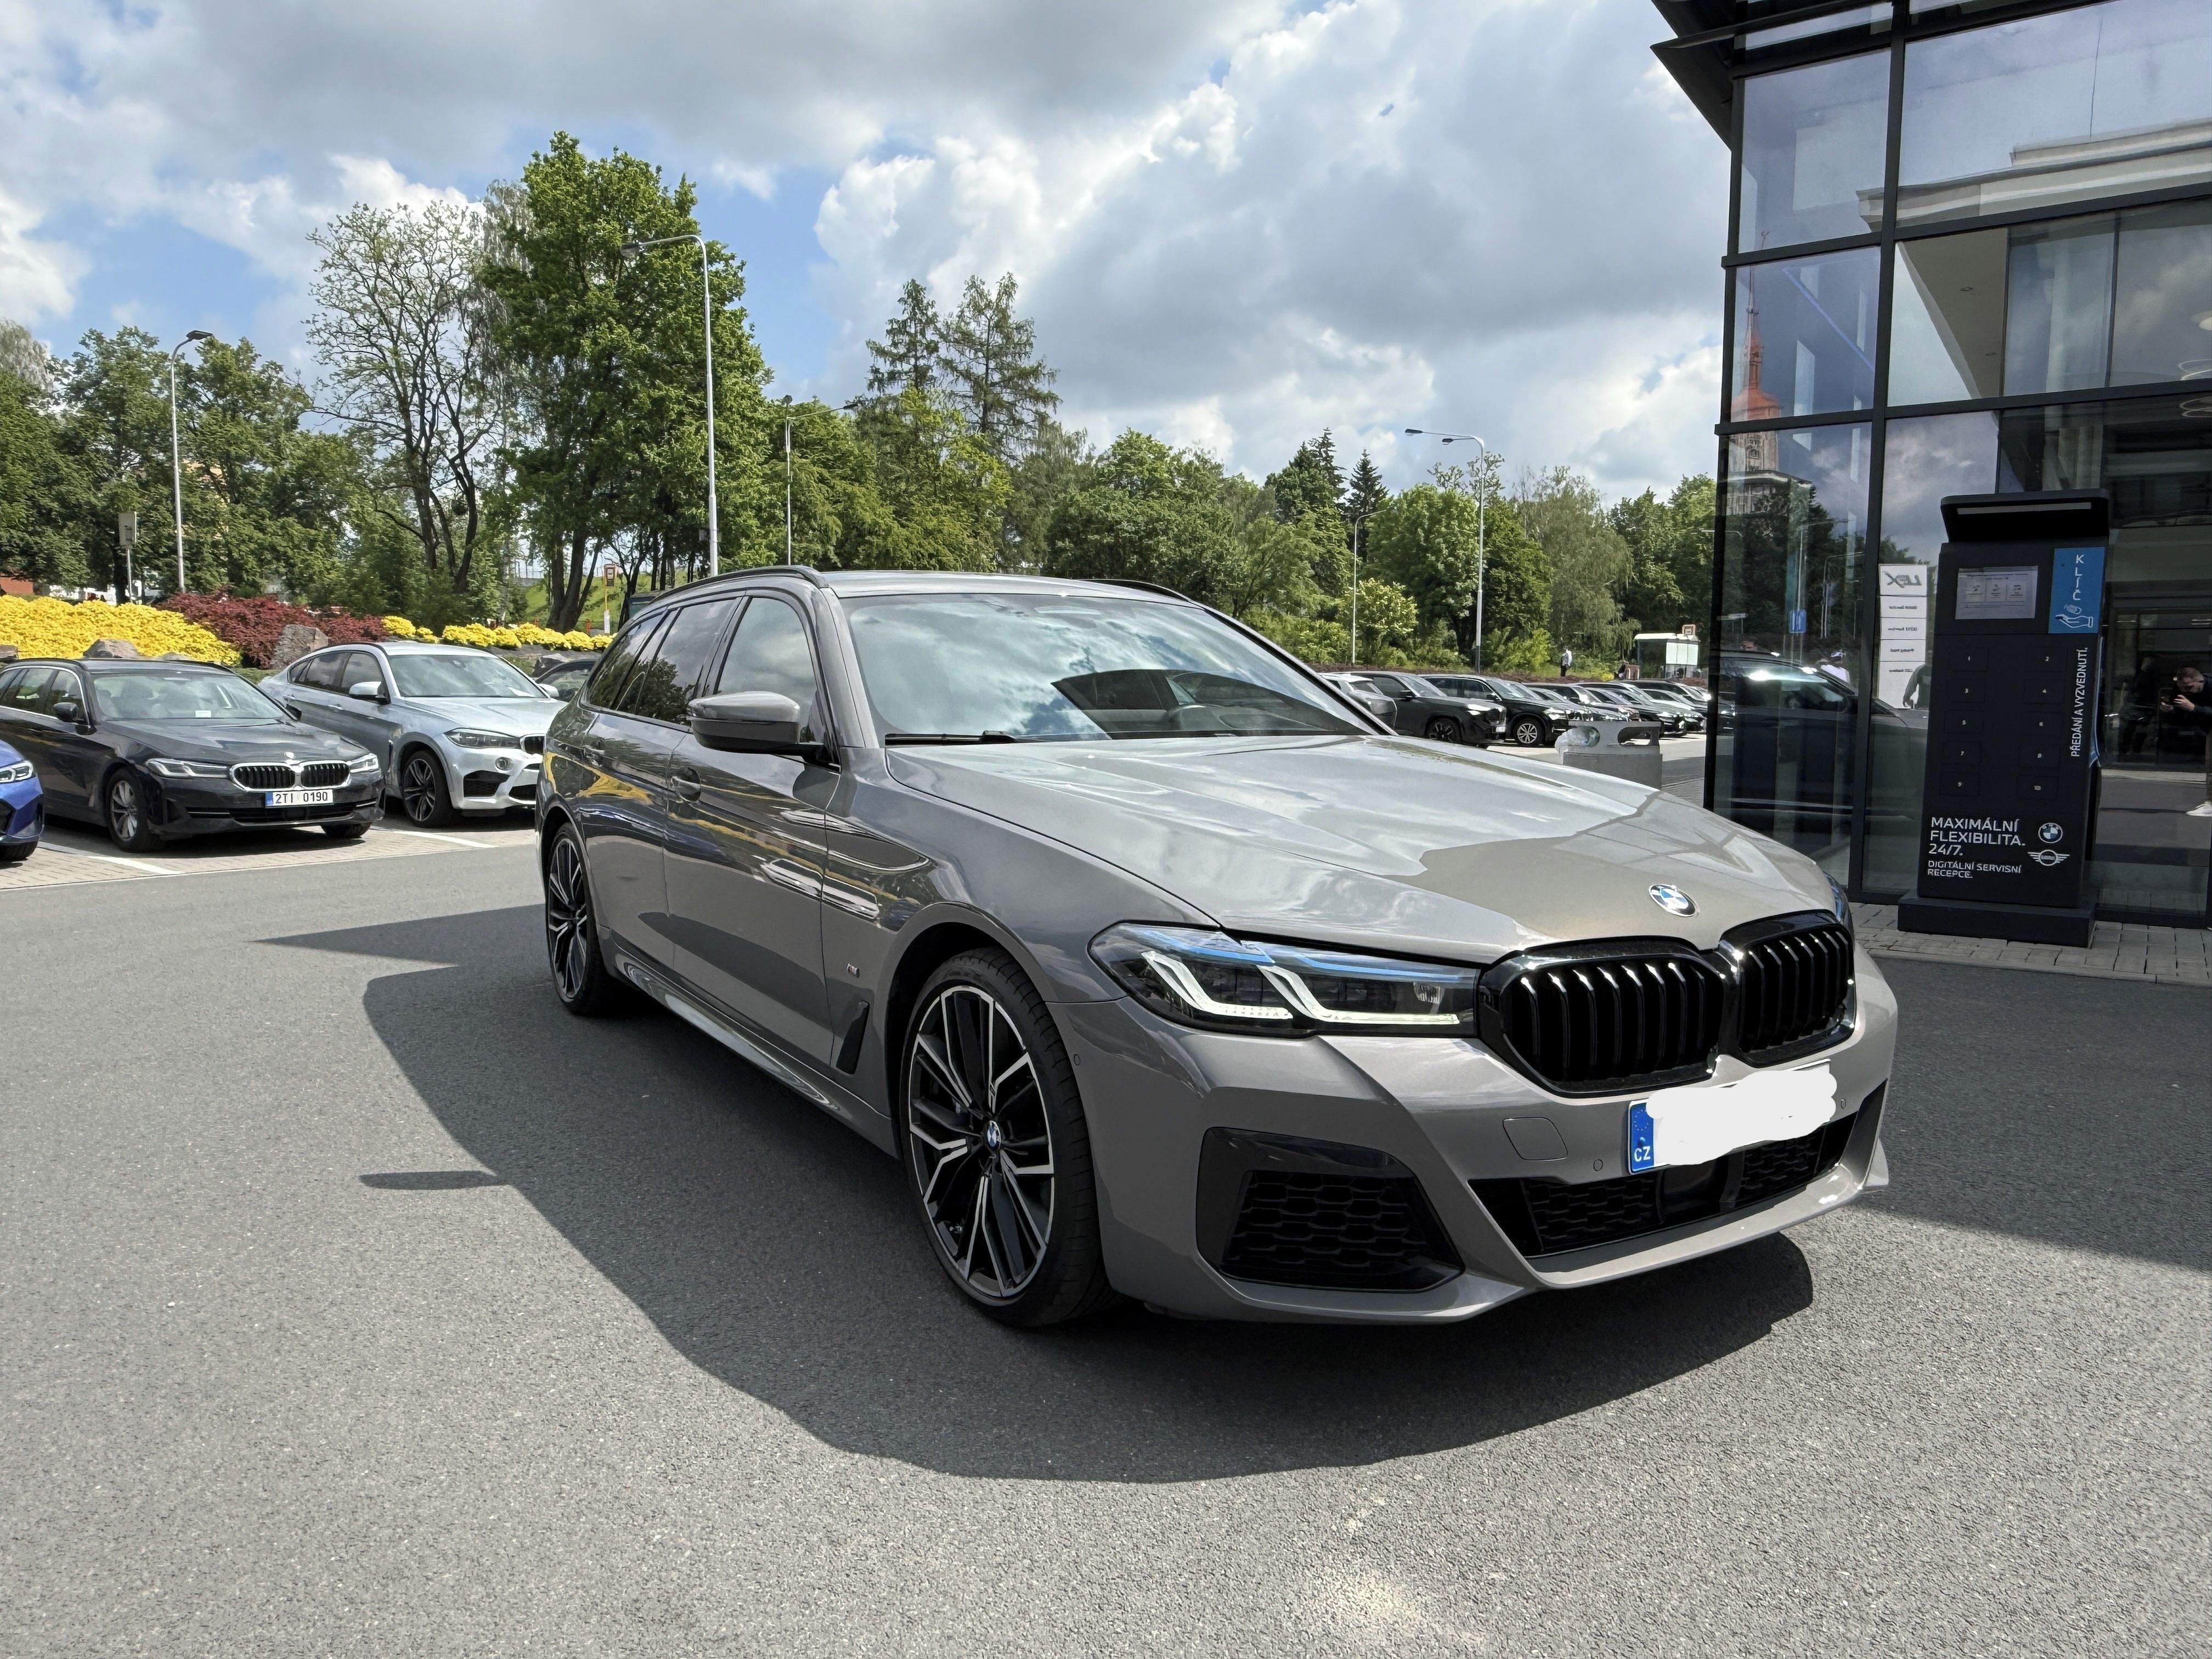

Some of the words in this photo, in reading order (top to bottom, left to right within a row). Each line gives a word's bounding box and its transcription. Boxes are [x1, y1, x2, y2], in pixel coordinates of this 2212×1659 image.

[2072, 554, 2085, 601] KLÍČ
[2069, 717, 2084, 757] PŘEDÁNÍ
[303, 791, 329, 802] 0190
[1931, 816, 2020, 833] MAXIMÁLNÍ
[1930, 830, 2025, 846] FLEXIBILITA.
[1928, 843, 1963, 856] 24/7.
[1928, 860, 1975, 870] DIGITÁLNÍ
[1976, 863, 2022, 873] SERVISNÍ
[1634, 1146, 1651, 1163] CZ
